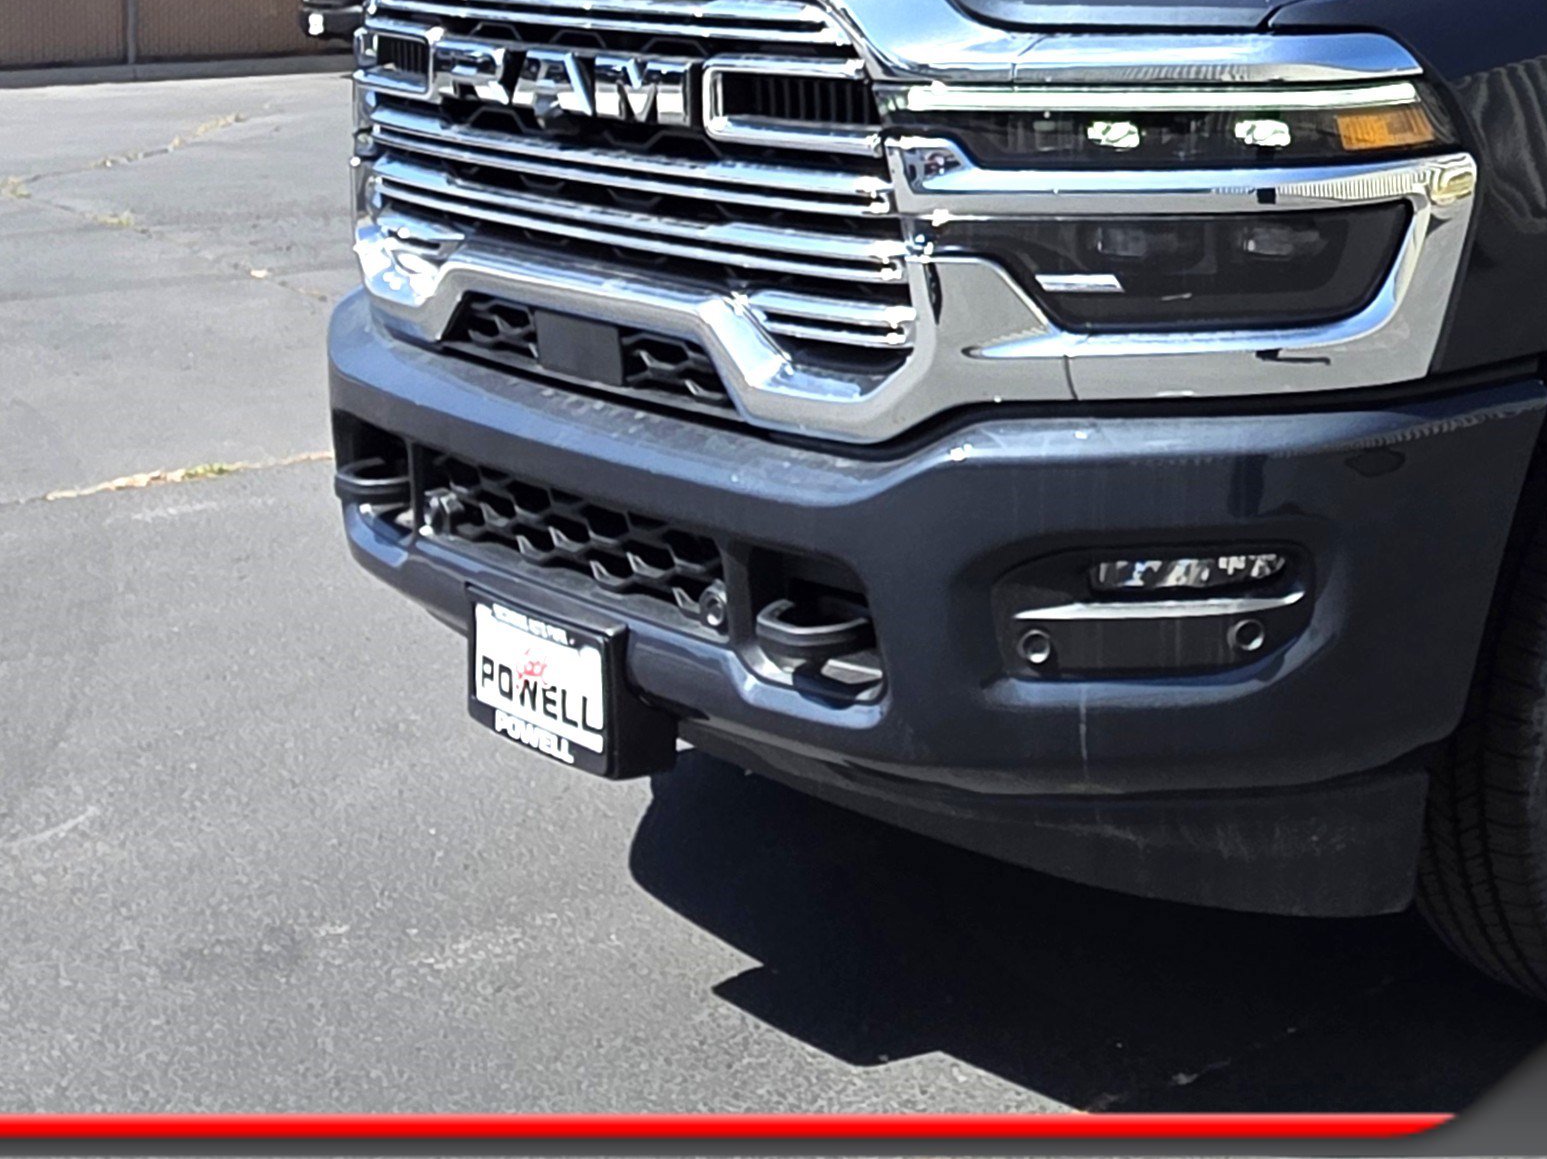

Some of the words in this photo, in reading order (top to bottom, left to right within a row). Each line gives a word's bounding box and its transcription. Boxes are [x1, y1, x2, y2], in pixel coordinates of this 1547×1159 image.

[432, 41, 697, 127] RAM
[481, 655, 604, 731] POWELL
[495, 708, 575, 765] POWELL
